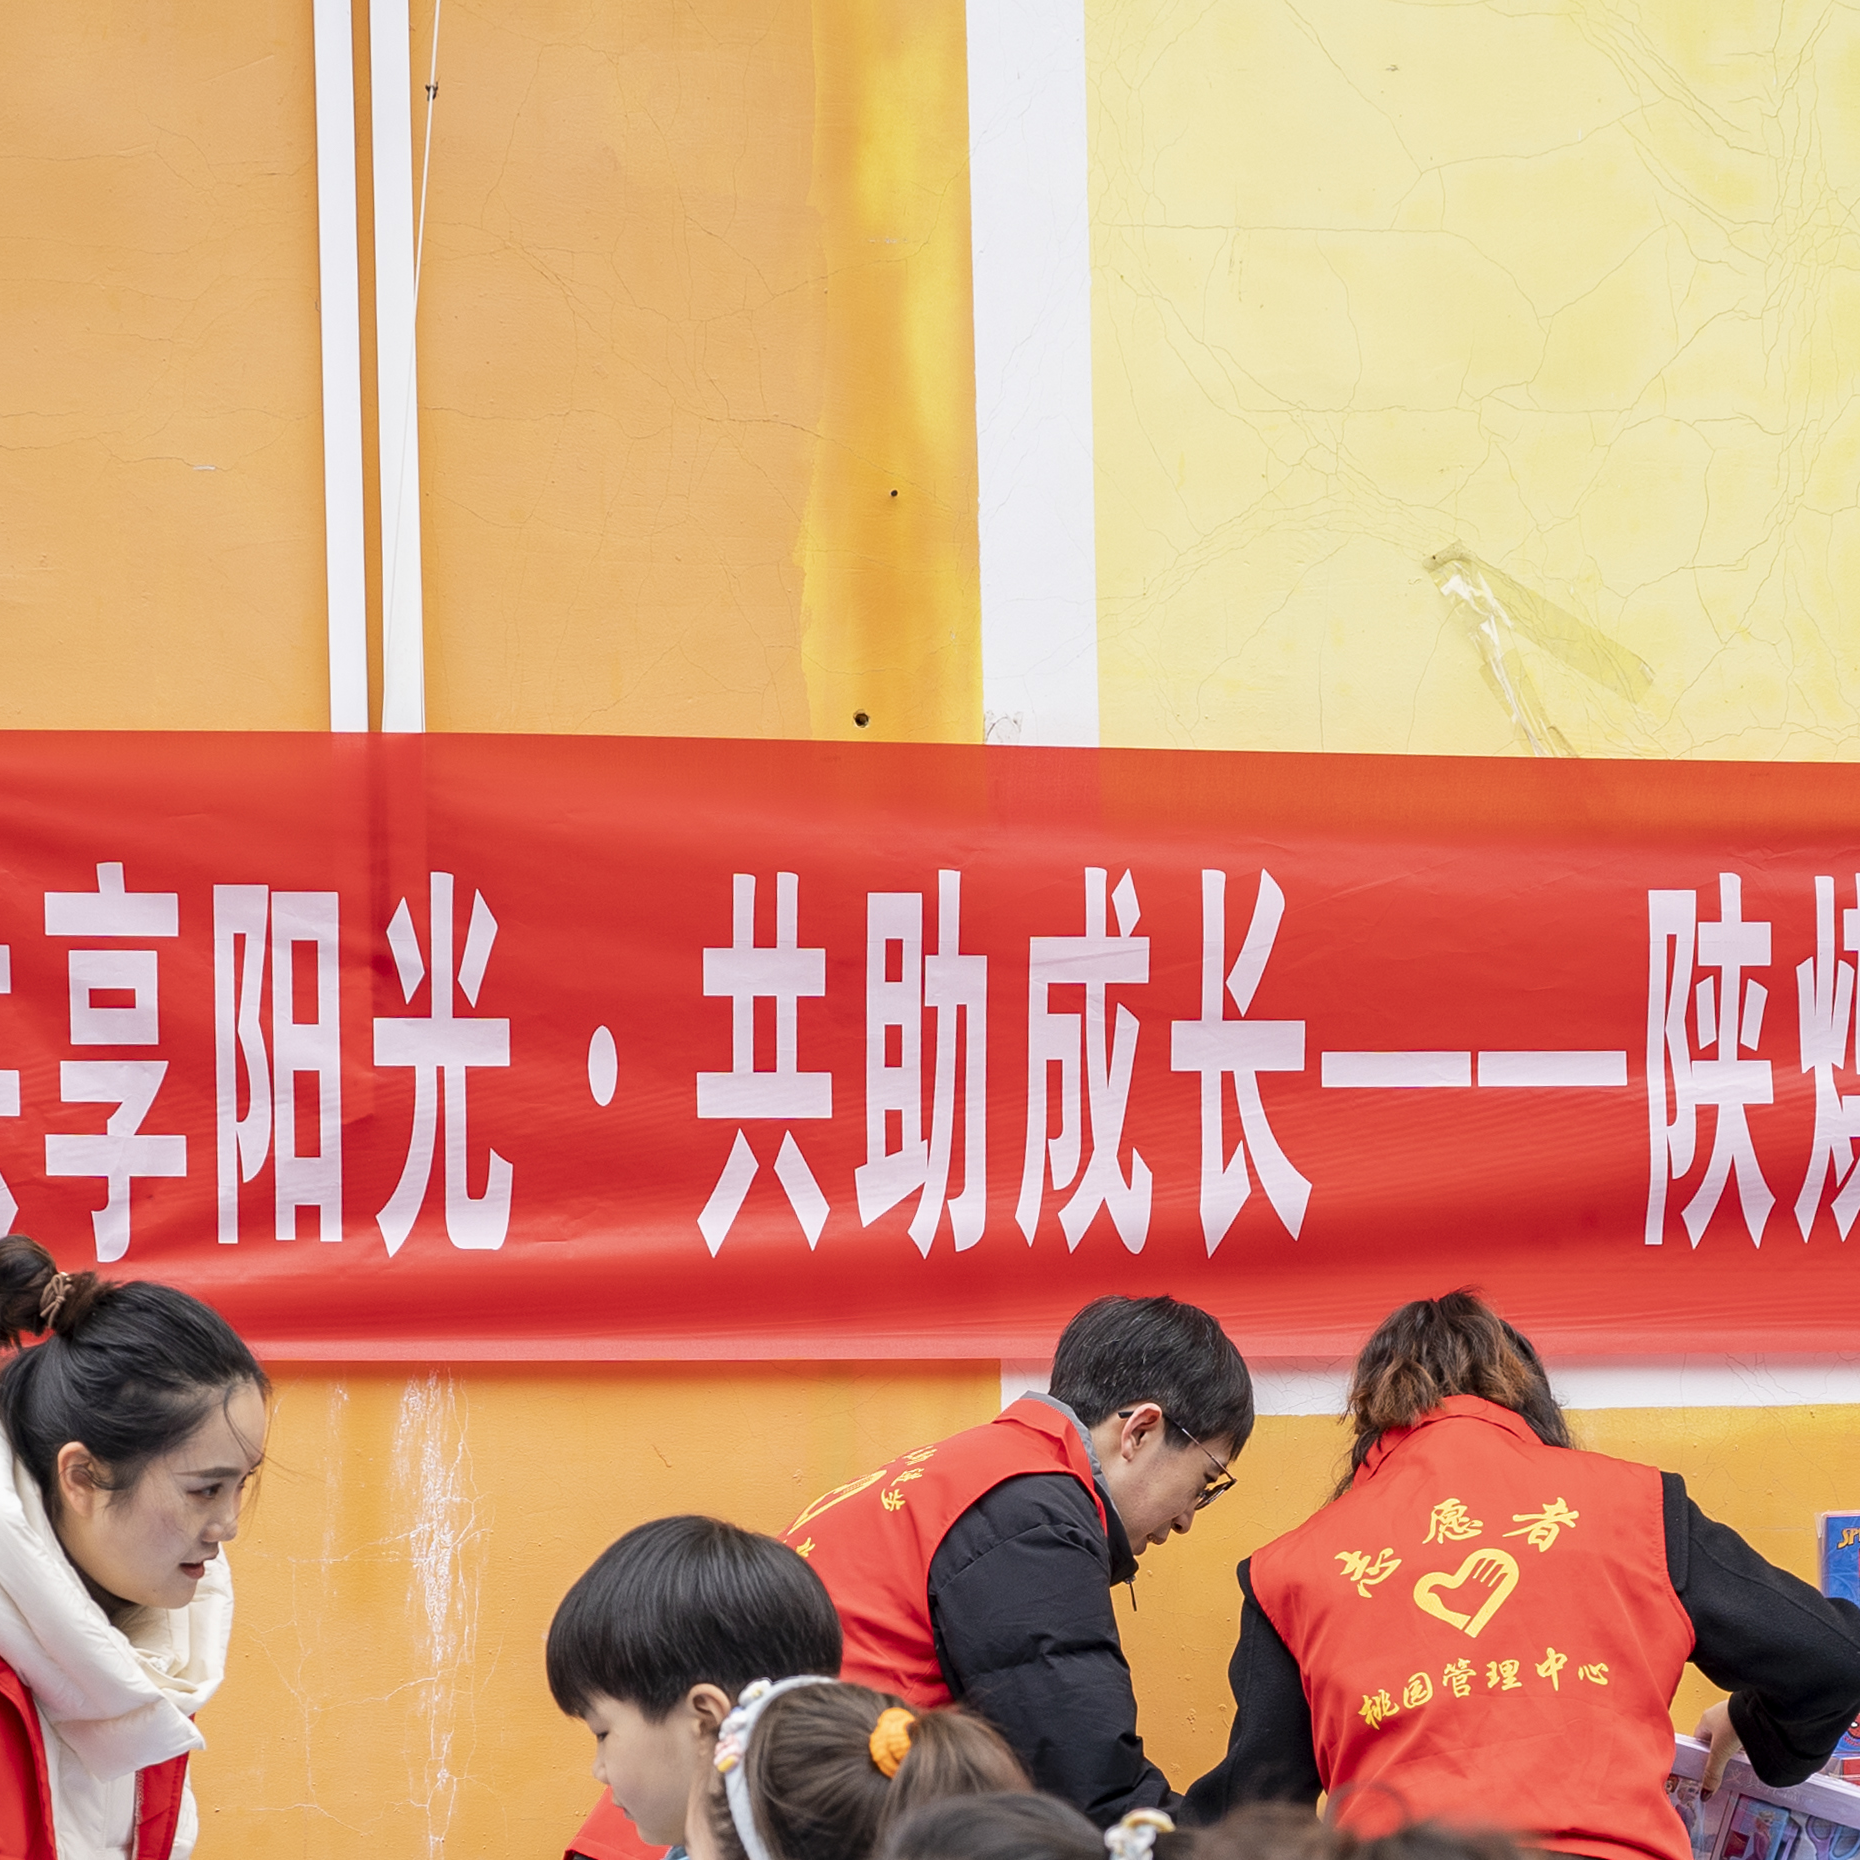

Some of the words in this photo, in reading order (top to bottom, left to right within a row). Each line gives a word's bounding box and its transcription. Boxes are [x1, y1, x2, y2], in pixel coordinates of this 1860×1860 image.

[1334, 1497, 1580, 1598] 志愿者
[1358, 1647, 1610, 1730] 桃园管理中心
